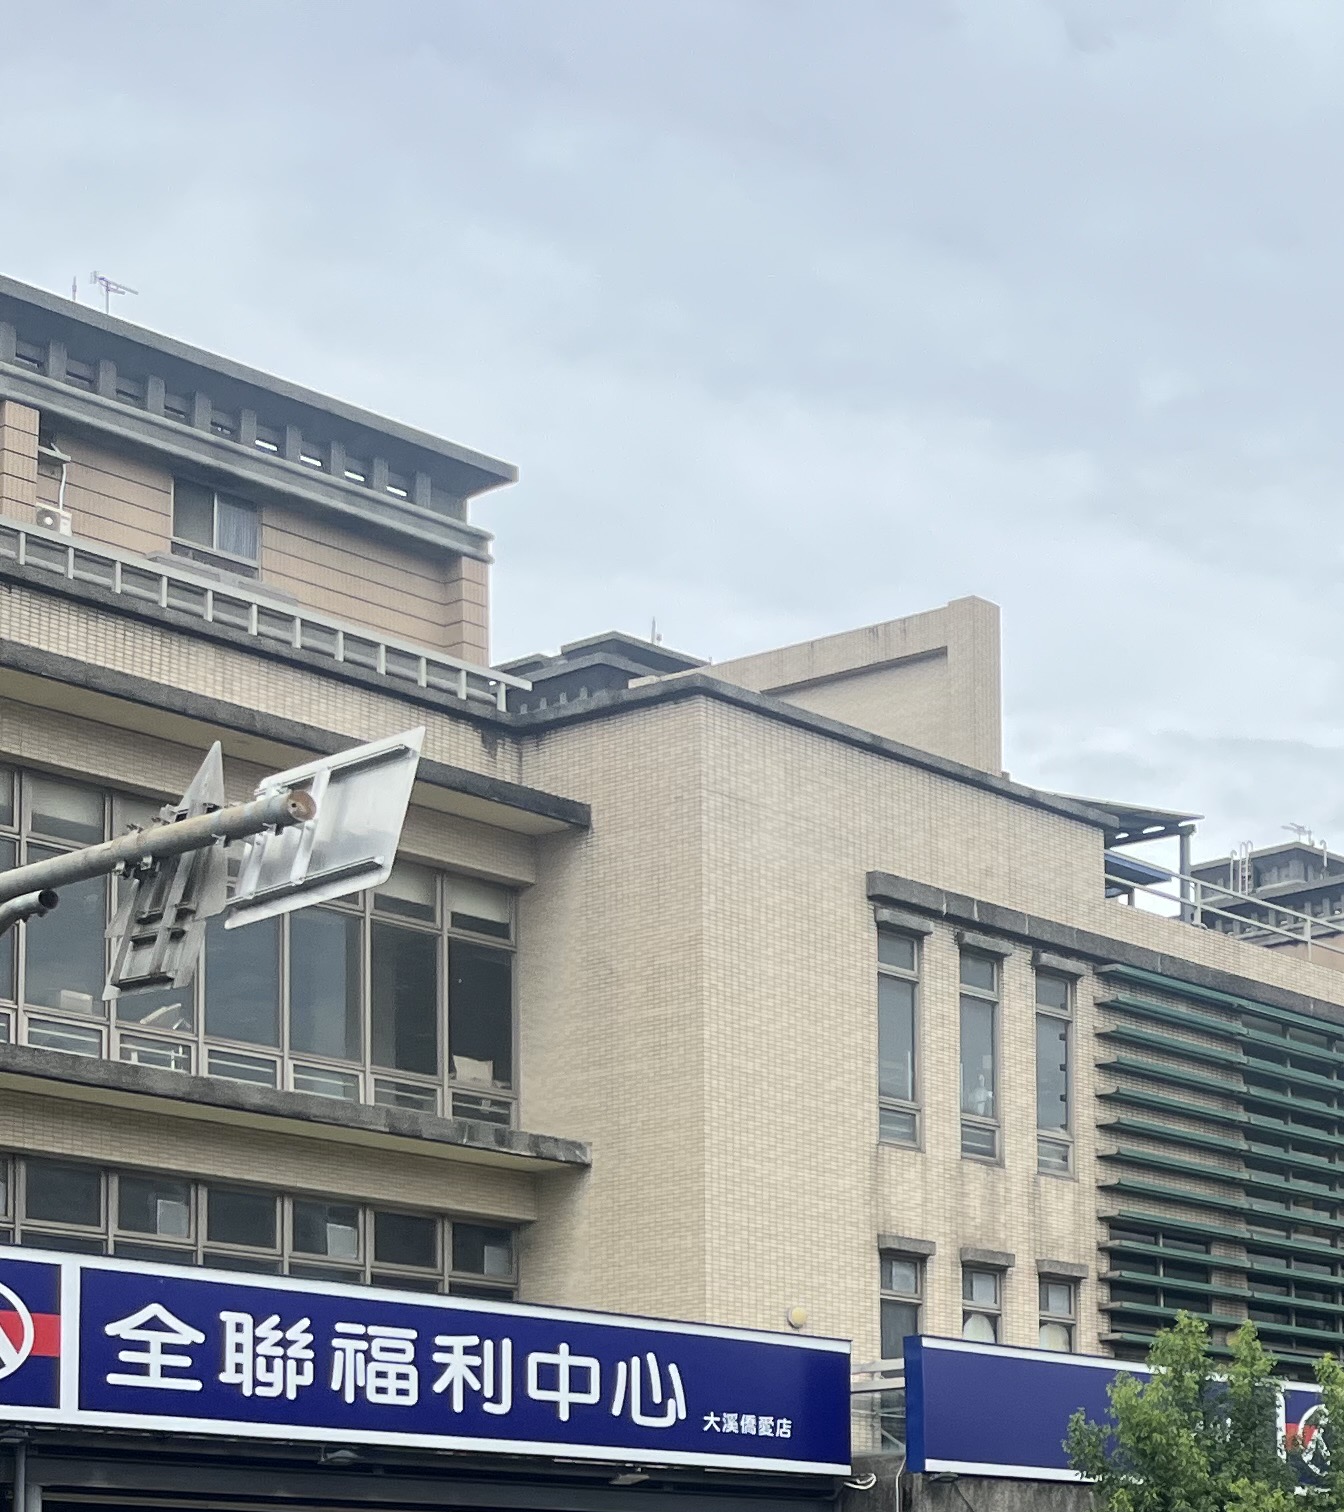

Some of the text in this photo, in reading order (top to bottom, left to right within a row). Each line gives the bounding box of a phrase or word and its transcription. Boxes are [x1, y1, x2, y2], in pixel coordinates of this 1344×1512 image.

[103, 1302, 687, 1429] 全聯福利中心
[703, 1412, 793, 1440] 大溪僑愛店
